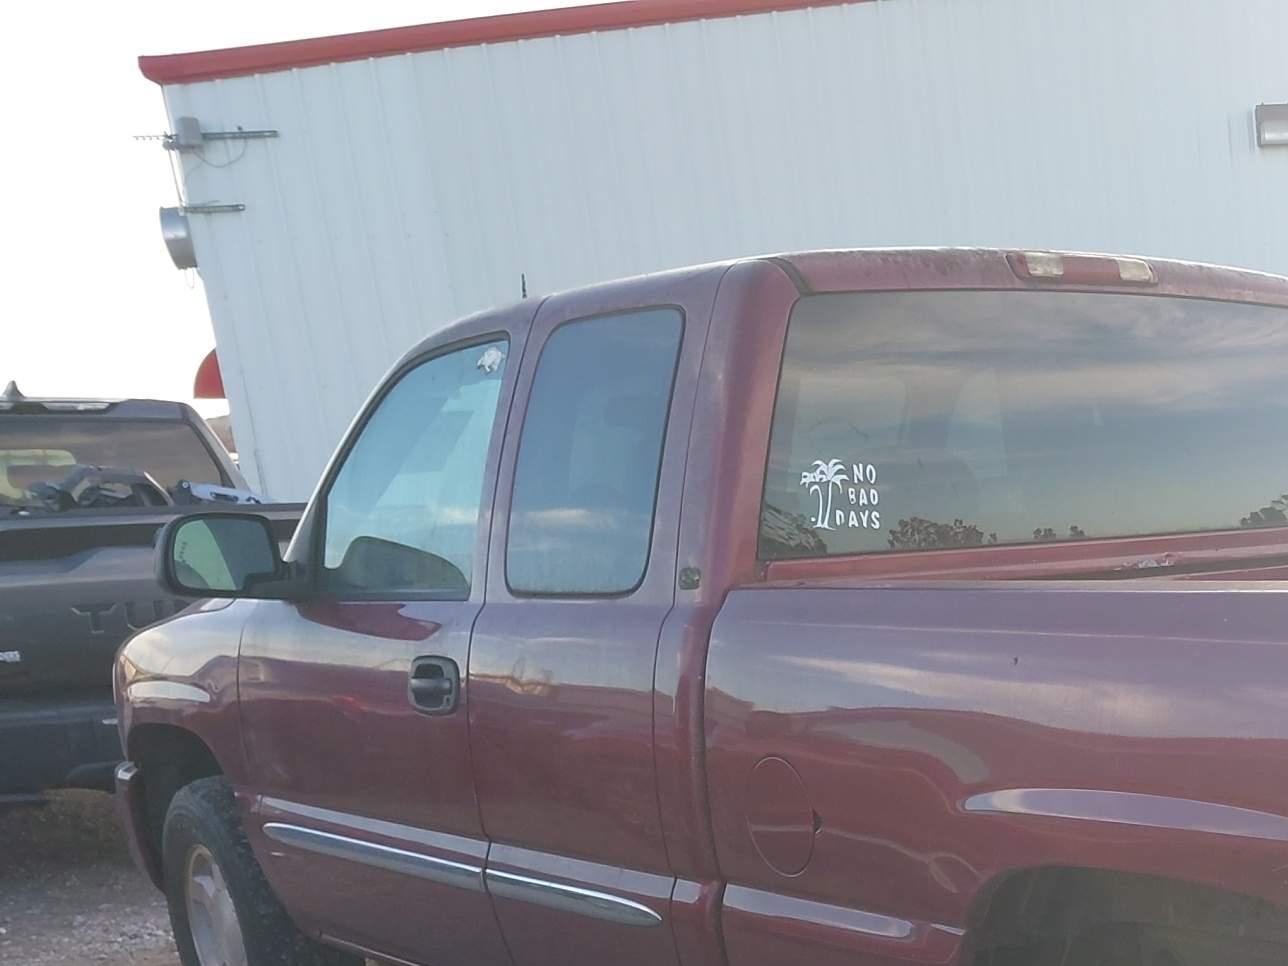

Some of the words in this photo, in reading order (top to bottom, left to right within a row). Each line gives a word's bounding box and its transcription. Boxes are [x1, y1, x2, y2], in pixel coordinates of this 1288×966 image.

[852, 463, 876, 484] NO
[848, 488, 879, 506] BAD
[835, 509, 881, 529] DAYS
